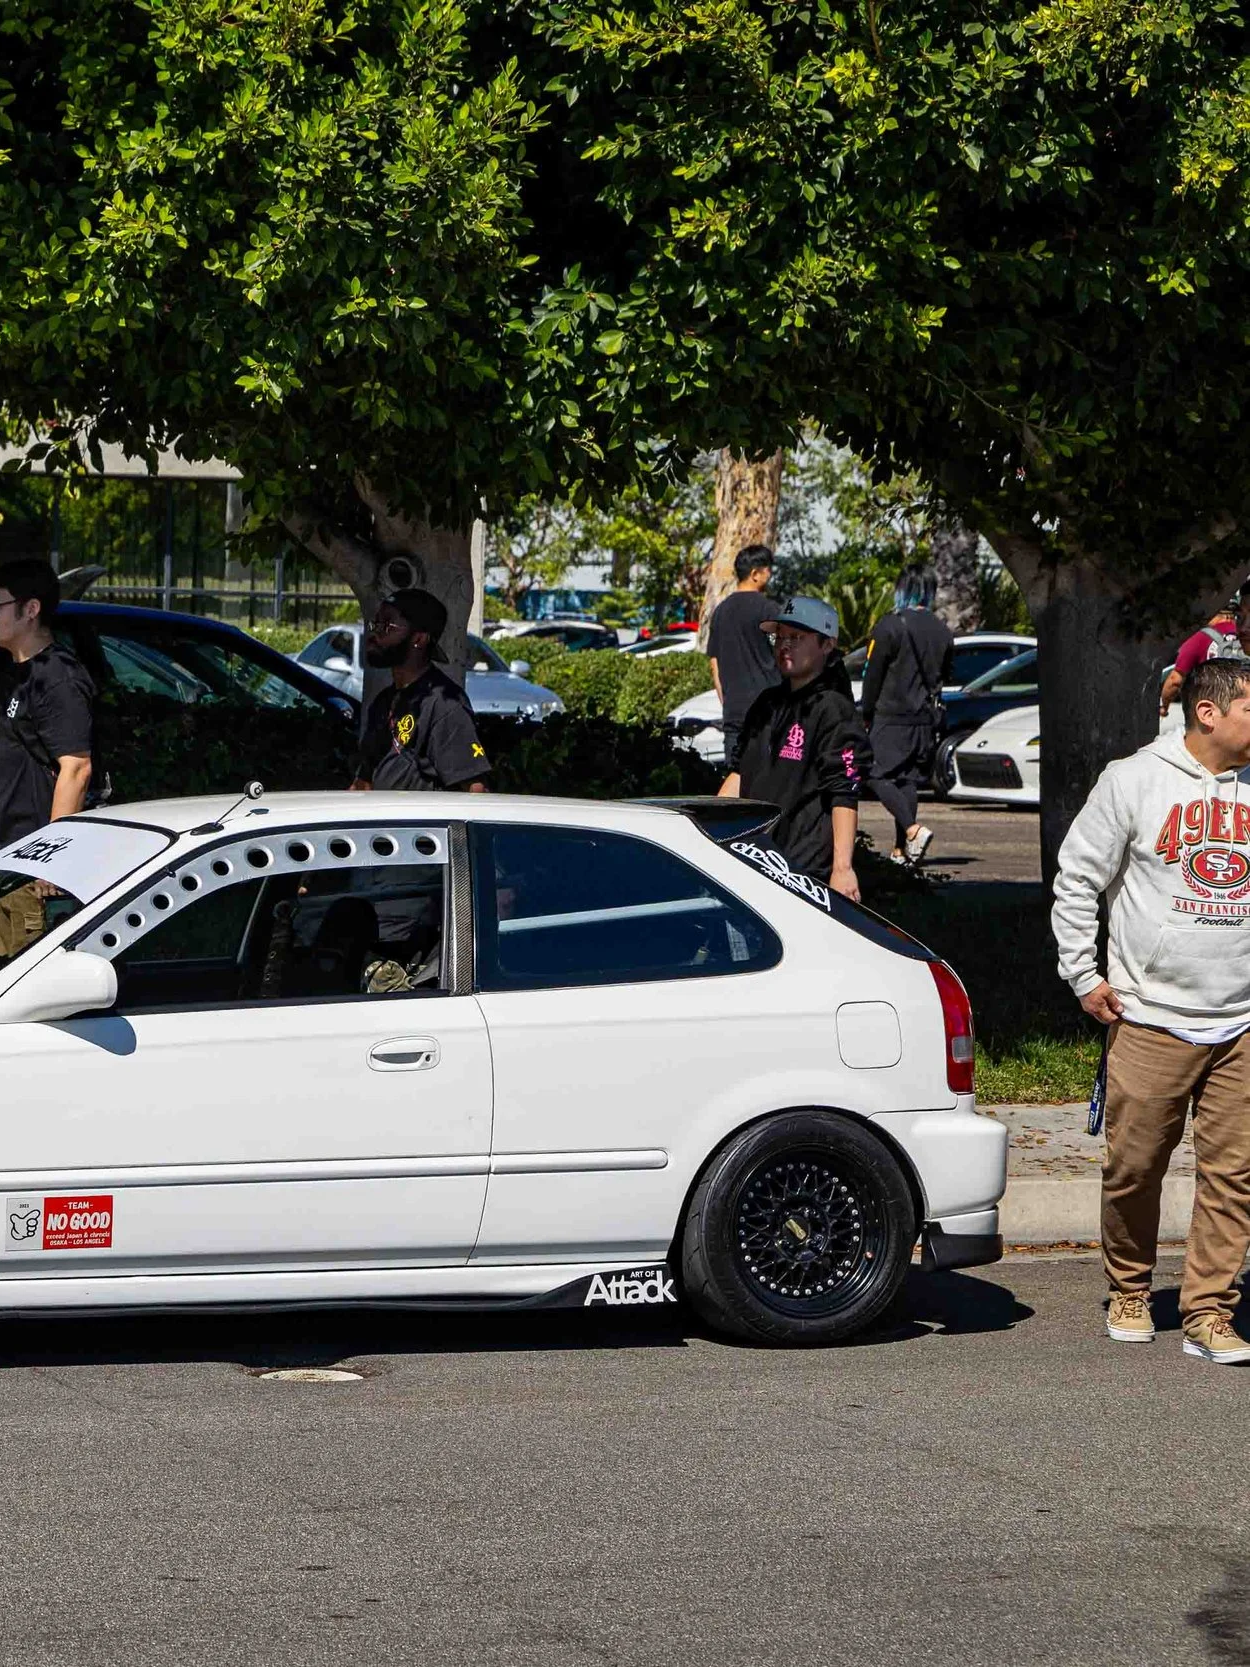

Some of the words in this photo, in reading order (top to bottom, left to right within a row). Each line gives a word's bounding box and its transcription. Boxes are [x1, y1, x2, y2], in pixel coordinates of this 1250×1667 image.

[1213, 891, 1227, 901] 1946
[1174, 898, 1196, 912] SAN
[1200, 903, 1250, 916] FRANCIS
[1194, 916, 1245, 927] Football
[47, 1213, 68, 1231] NO
[70, 1211, 110, 1230] GOOD
[584, 1270, 678, 1306] Attack
